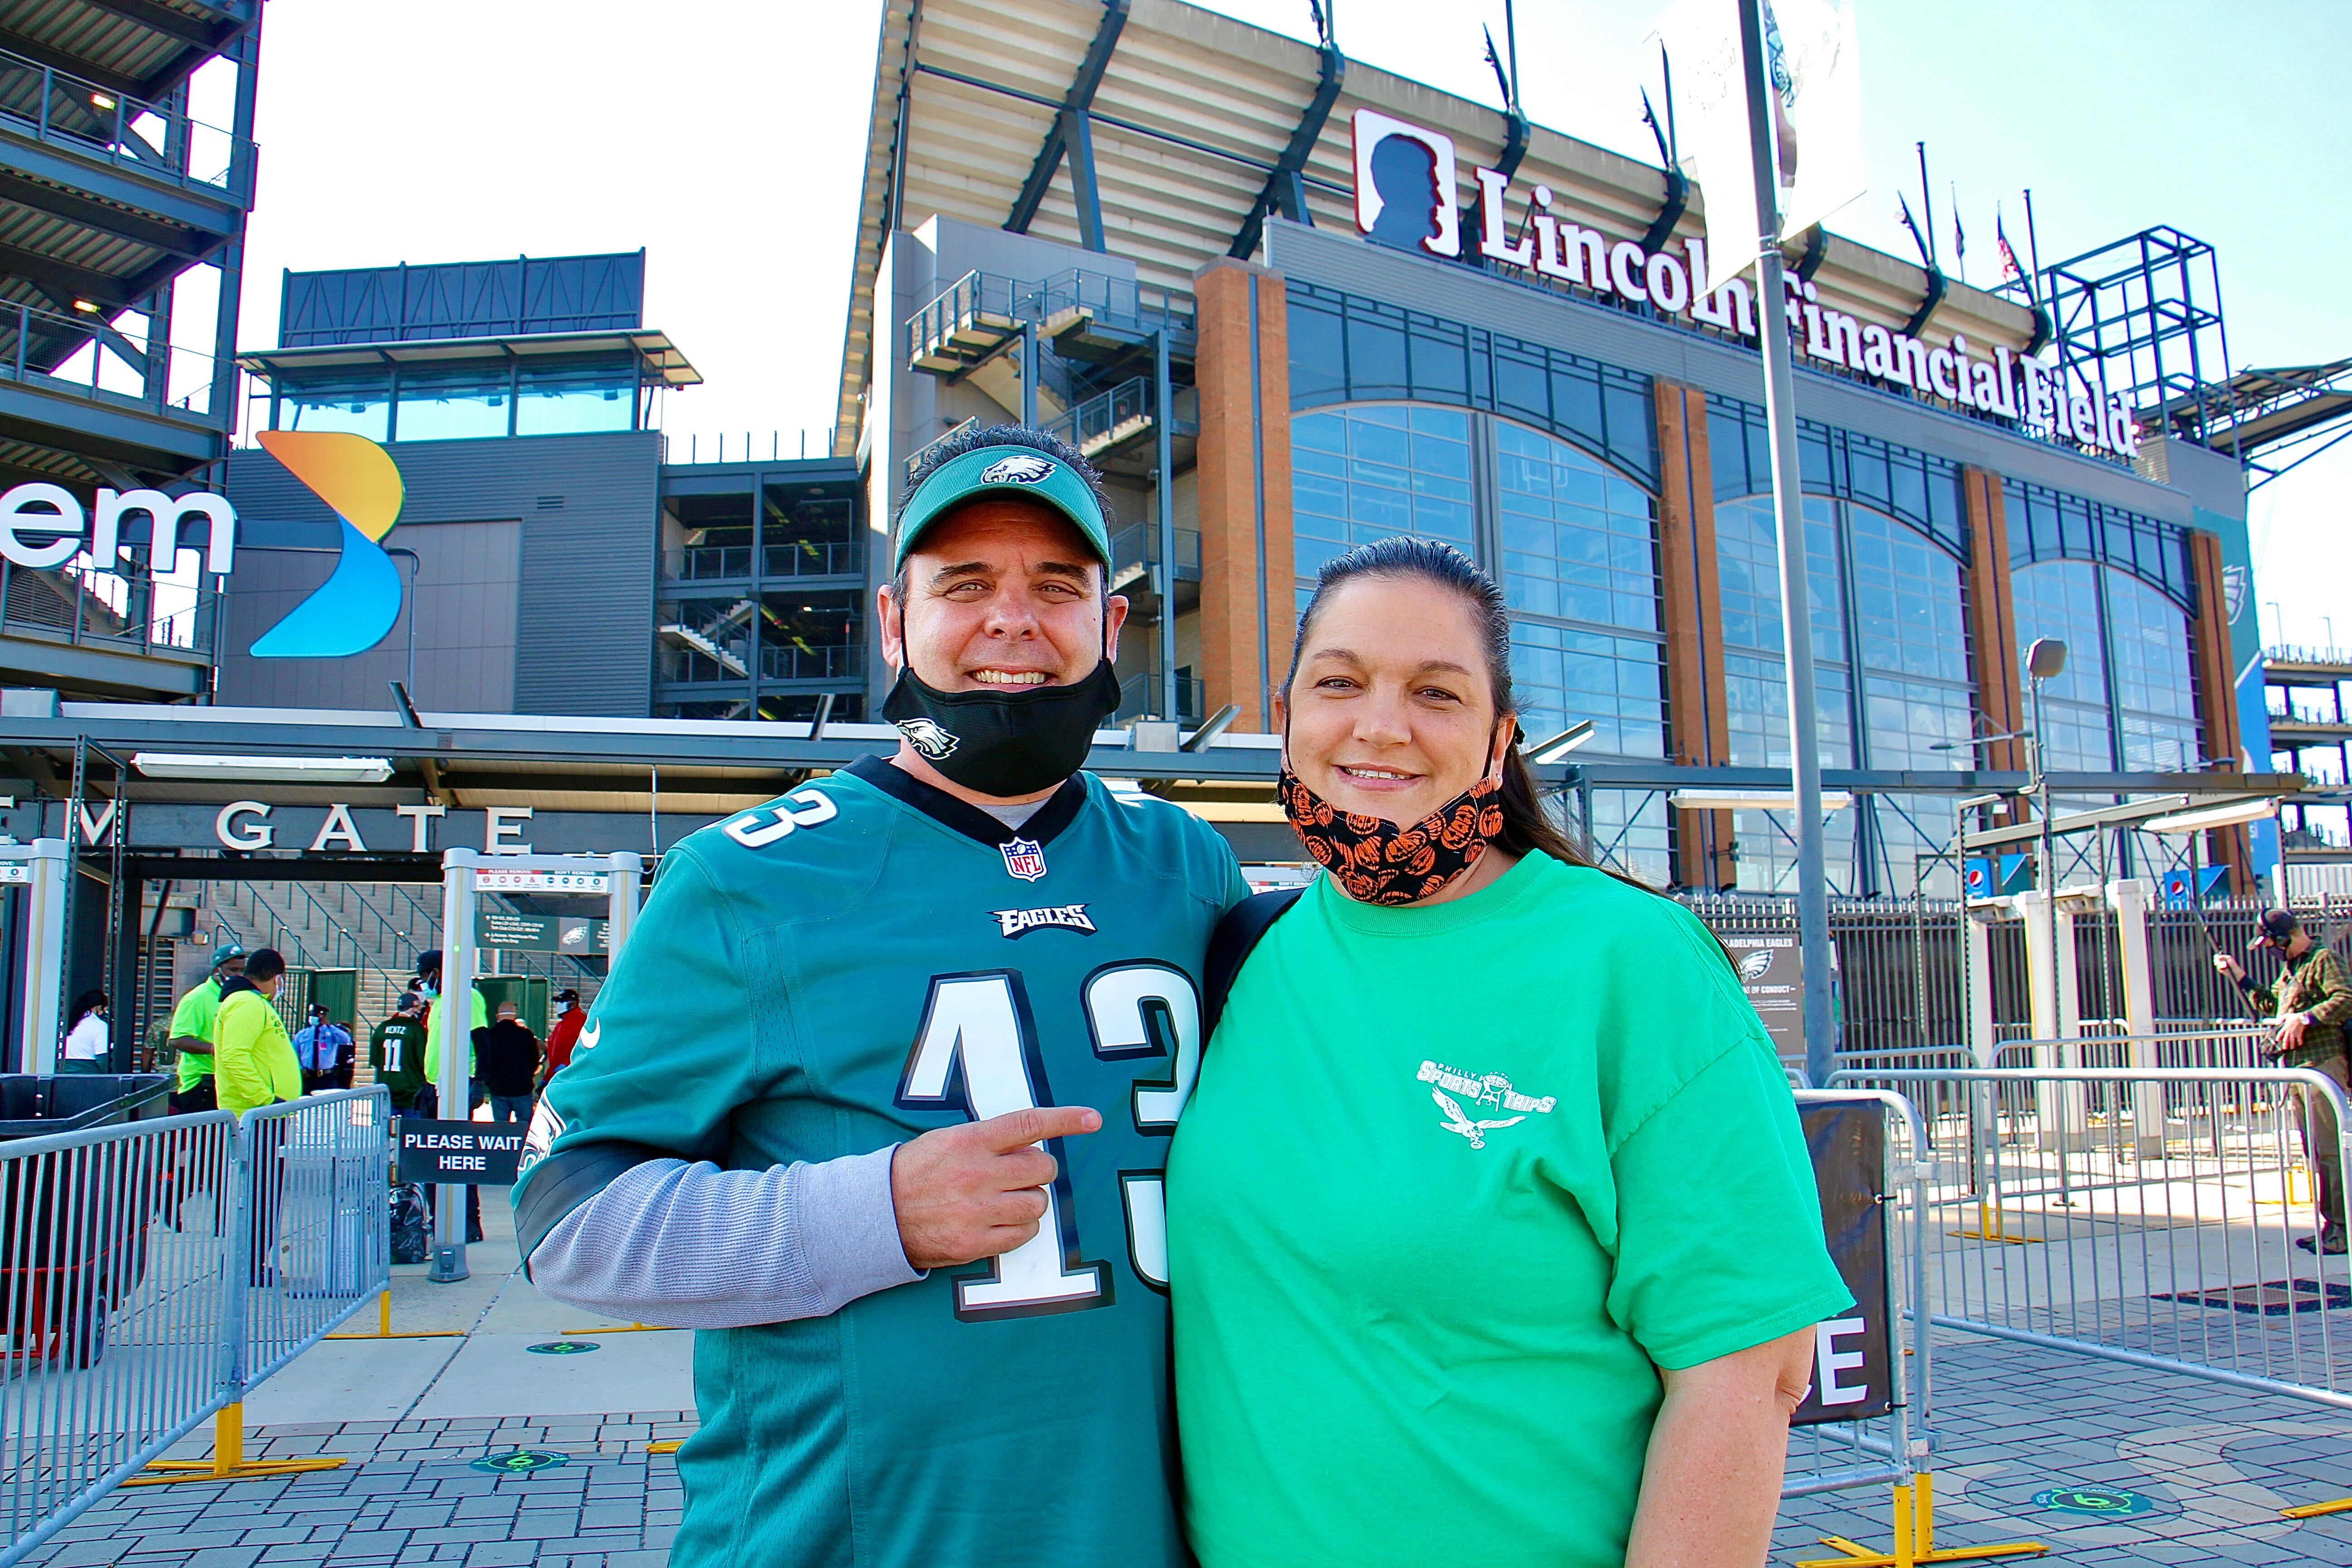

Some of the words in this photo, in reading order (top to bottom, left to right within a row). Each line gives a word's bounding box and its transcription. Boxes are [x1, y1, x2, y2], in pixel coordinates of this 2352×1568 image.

[1474, 167, 1756, 337] Lincoln
[2019, 354, 2138, 459] Field
[216, 800, 534, 855] GATE
[1011, 855, 1041, 874] NFL
[993, 904, 1096, 936] EAGLES
[1765, 939, 1793, 947] EAGLES
[1761, 985, 1790, 994] CONDUCT
[383, 1039, 401, 1072] 11
[1437, 1063, 1477, 1079] PHILLY
[1416, 1060, 1483, 1098] SPORTS
[1503, 1089, 1557, 1113] TRIPS
[405, 1135, 473, 1149] PLEASE
[478, 1136, 522, 1151] WAIT
[893, 958, 1202, 1323] 13
[439, 1156, 486, 1171] HERE
[506, 1455, 534, 1465] 6
[2073, 1494, 2110, 1506] 6
